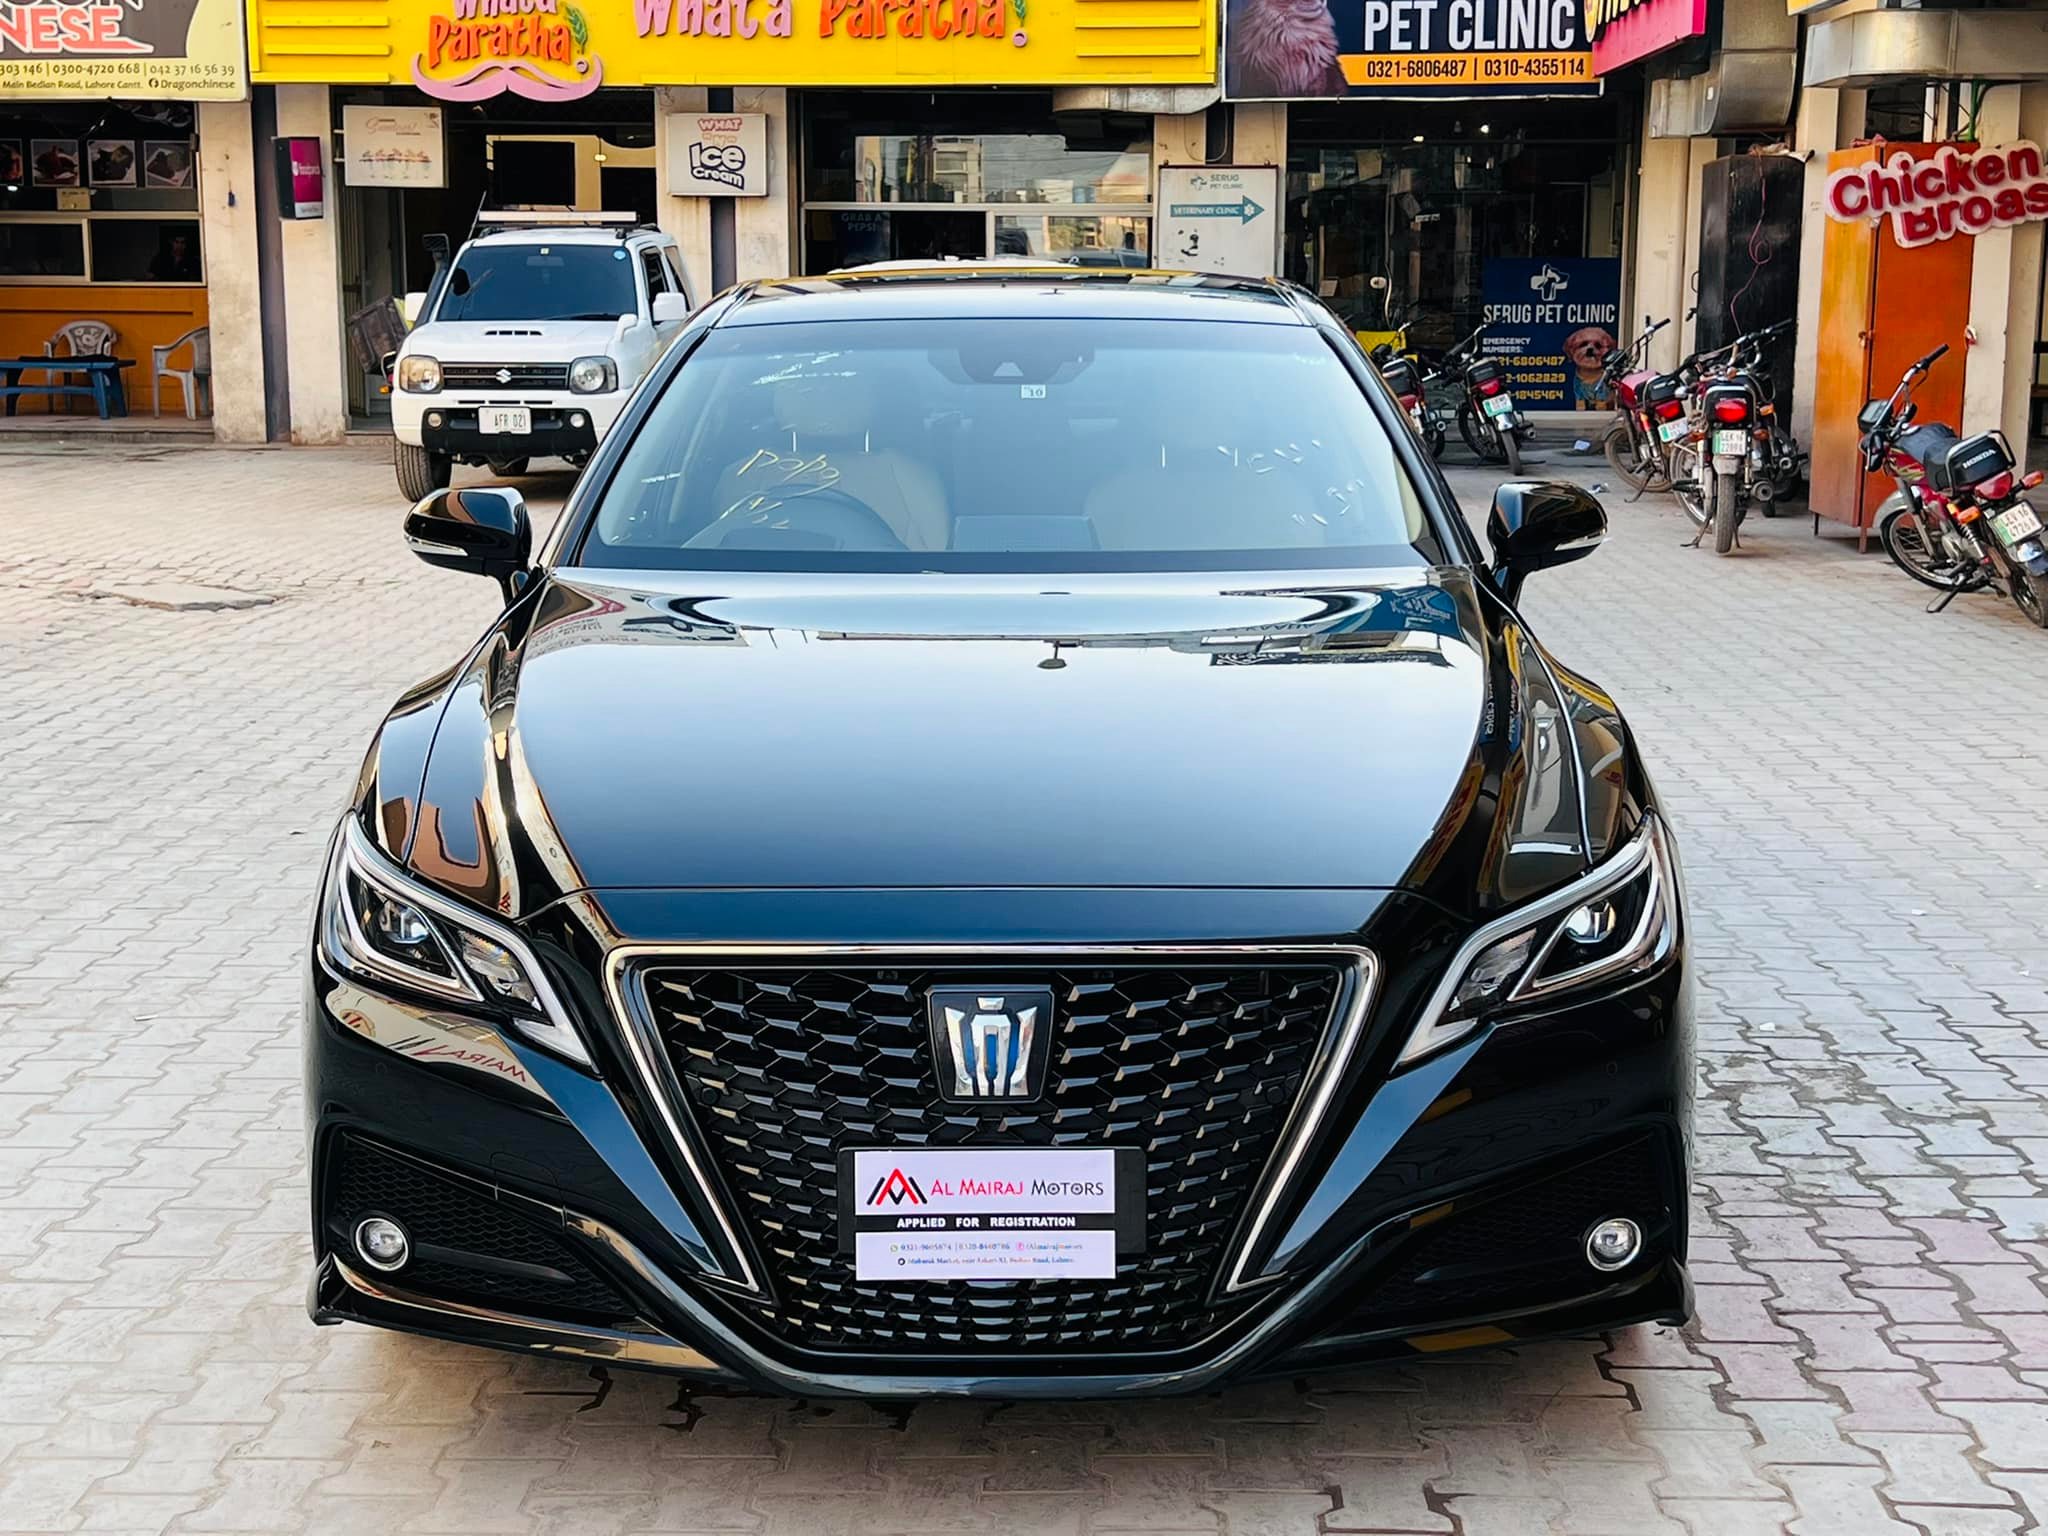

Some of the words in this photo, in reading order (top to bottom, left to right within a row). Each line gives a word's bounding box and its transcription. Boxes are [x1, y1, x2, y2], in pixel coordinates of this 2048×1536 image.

[1364, 2, 1440, 51] PET
[1448, 0, 1577, 50] CLINIC
[53, 64, 115, 76] 0300-4720
[118, 63, 140, 74] 668
[150, 66, 171, 76] 042
[174, 66, 187, 76] 37
[190, 64, 201, 74] 16
[204, 64, 218, 75] 56
[221, 66, 235, 77] 39
[1367, 60, 1467, 78] 0321-6806487
[1484, 58, 1585, 77] 0310-4355114
[161, 79, 236, 91] Dragonchinese
[698, 118, 742, 131] WHAT
[689, 142, 746, 171] Ice
[1832, 147, 2040, 218] Chicken
[1536, 304, 1563, 323] PET
[1567, 304, 1615, 323] CLINIC
[1962, 449, 1997, 469] HONDA
[897, 1217, 946, 1229] APPLIED
[956, 1217, 980, 1228] FOR
[990, 1217, 1076, 1228] REGISTRATION
